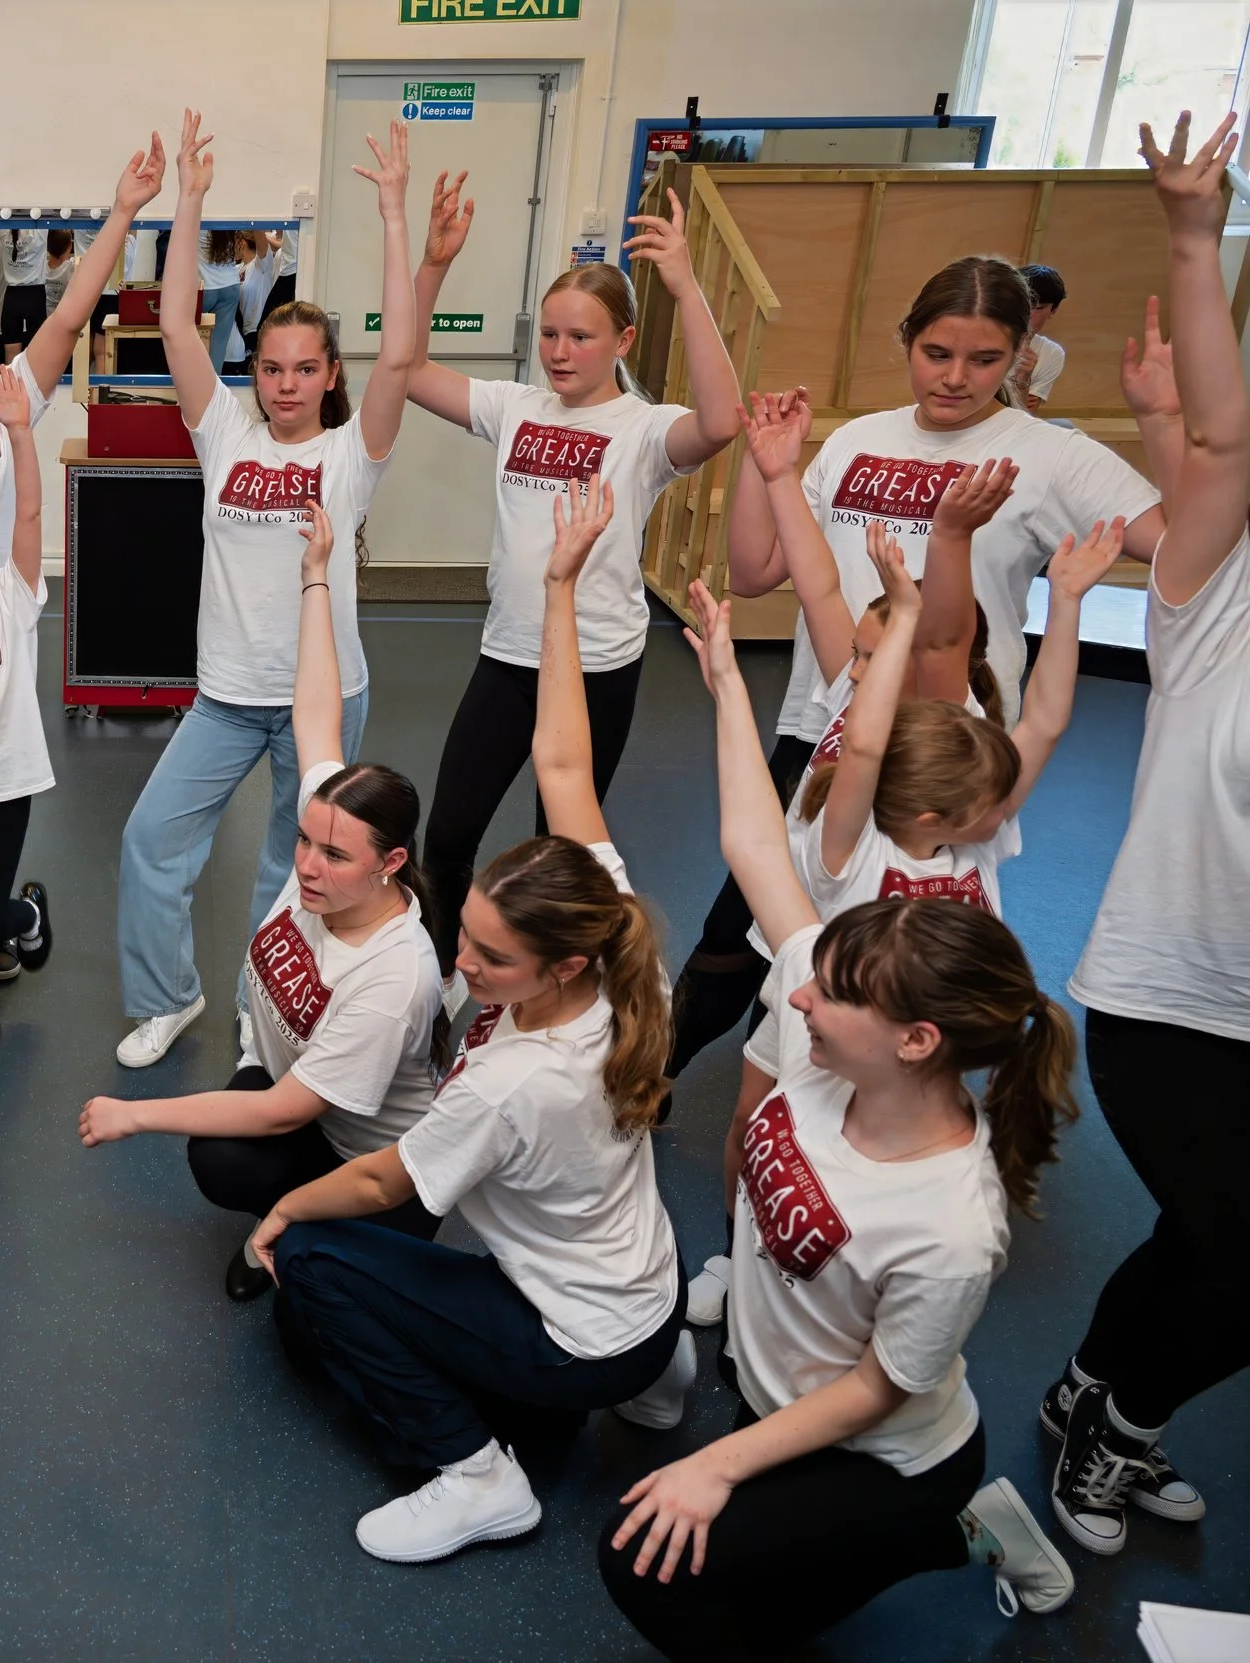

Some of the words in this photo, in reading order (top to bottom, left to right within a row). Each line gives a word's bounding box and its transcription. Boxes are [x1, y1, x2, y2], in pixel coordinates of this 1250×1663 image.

[410, 0, 485, 18] FIRE
[496, 0, 567, 16] EXIT
[423, 85, 447, 98] Fire
[449, 85, 473, 98] exit
[422, 106, 446, 116] Keep
[448, 106, 471, 116] clear
[439, 318, 450, 328] to
[453, 319, 481, 329] open
[515, 435, 602, 469] GREASE
[521, 462, 535, 472] THE
[539, 466, 574, 477] MUSICAL
[232, 471, 317, 502] GREASE
[502, 472, 556, 492] DOSYTCo
[561, 482, 589, 496] 225
[217, 506, 282, 523] DOSYTCo
[241, 497, 258, 508] THE
[856, 497, 875, 510] THE
[879, 502, 928, 516] MUSICAL
[831, 510, 902, 534] DOSYCo
[909, 883, 924, 895] WE
[928, 881, 943, 893] GO
[285, 928, 298, 943] WE
[295, 941, 305, 954] GO
[260, 926, 319, 1024] GREASE
[255, 957, 266, 976] THE
[265, 977, 291, 1020] MUSICAL
[294, 1022, 304, 1033] 59
[275, 1017, 301, 1047] 2025
[778, 1140, 794, 1158] GO
[789, 1160, 824, 1213] TOGETHER
[743, 1117, 826, 1264] GREASE
